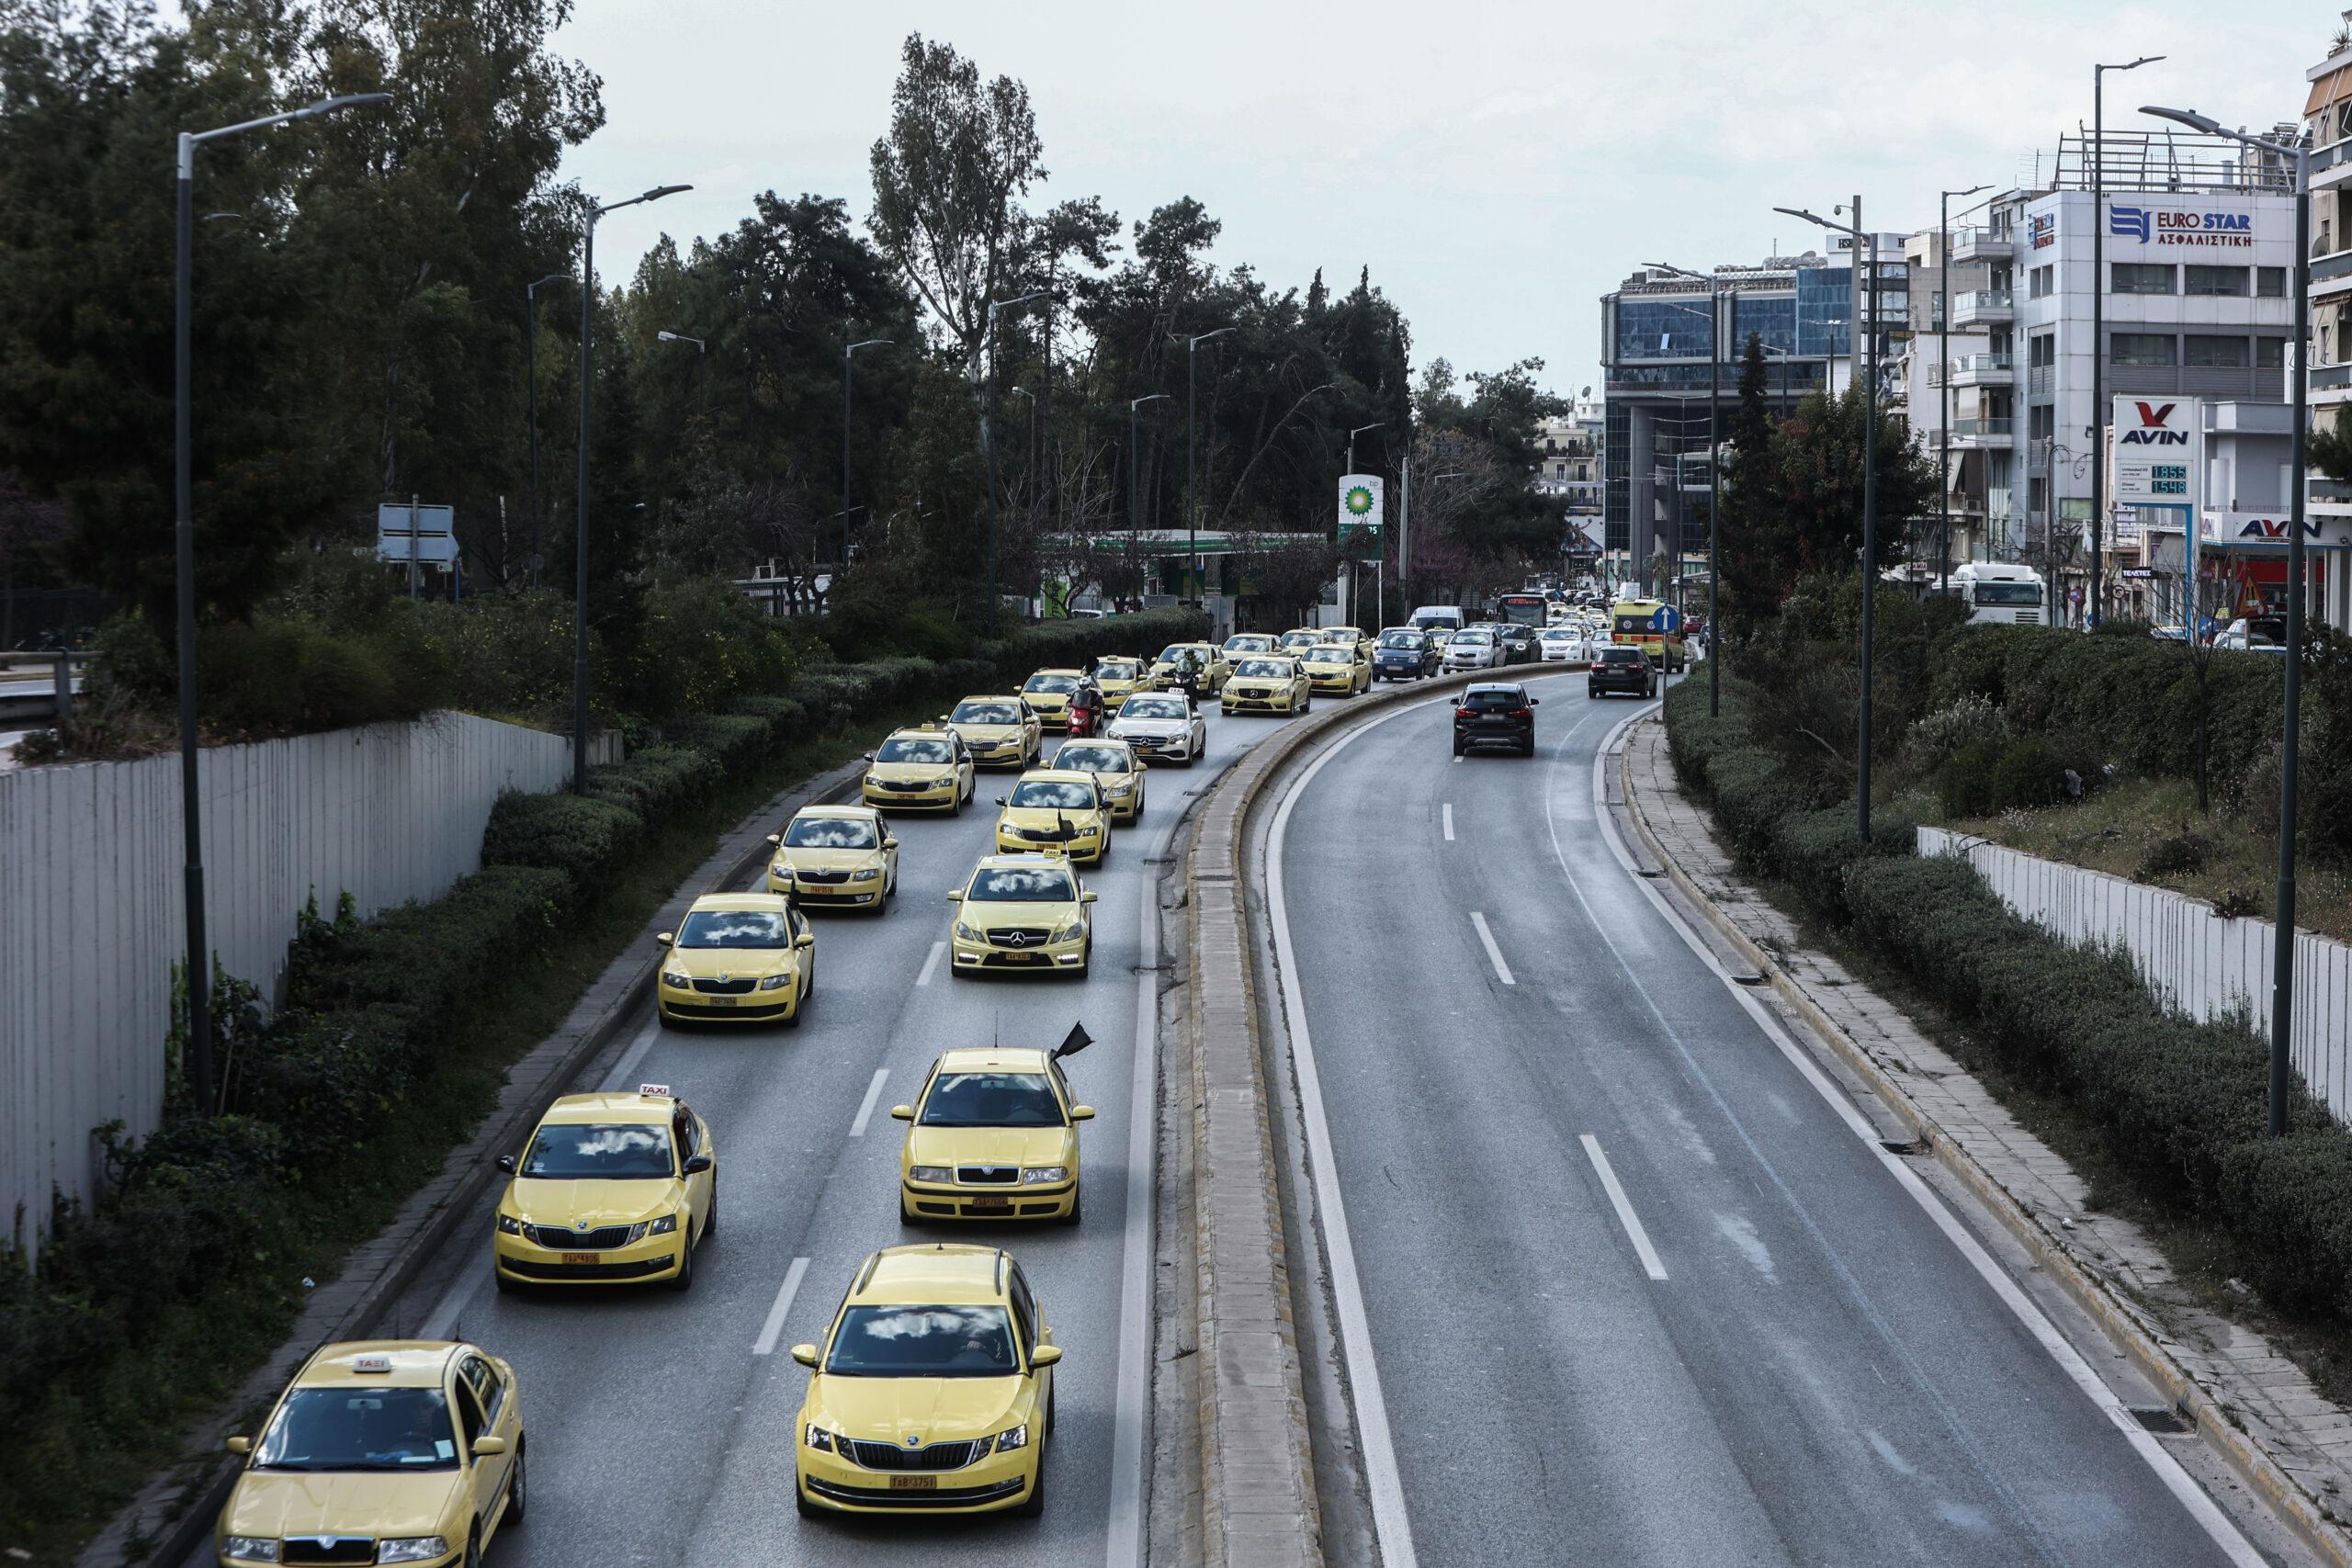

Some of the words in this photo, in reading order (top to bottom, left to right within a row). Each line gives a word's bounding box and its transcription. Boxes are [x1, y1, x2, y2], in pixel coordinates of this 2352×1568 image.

[2157, 212, 2200, 228] EURO
[2203, 213, 2250, 230] STAR
[2158, 233, 2252, 247] ΑΣΦΑΛΙΣΤΙΚΗ
[2120, 430, 2188, 446] AVIN
[2154, 481, 2186, 493] 1.548
[642, 1086, 667, 1095] TAXI
